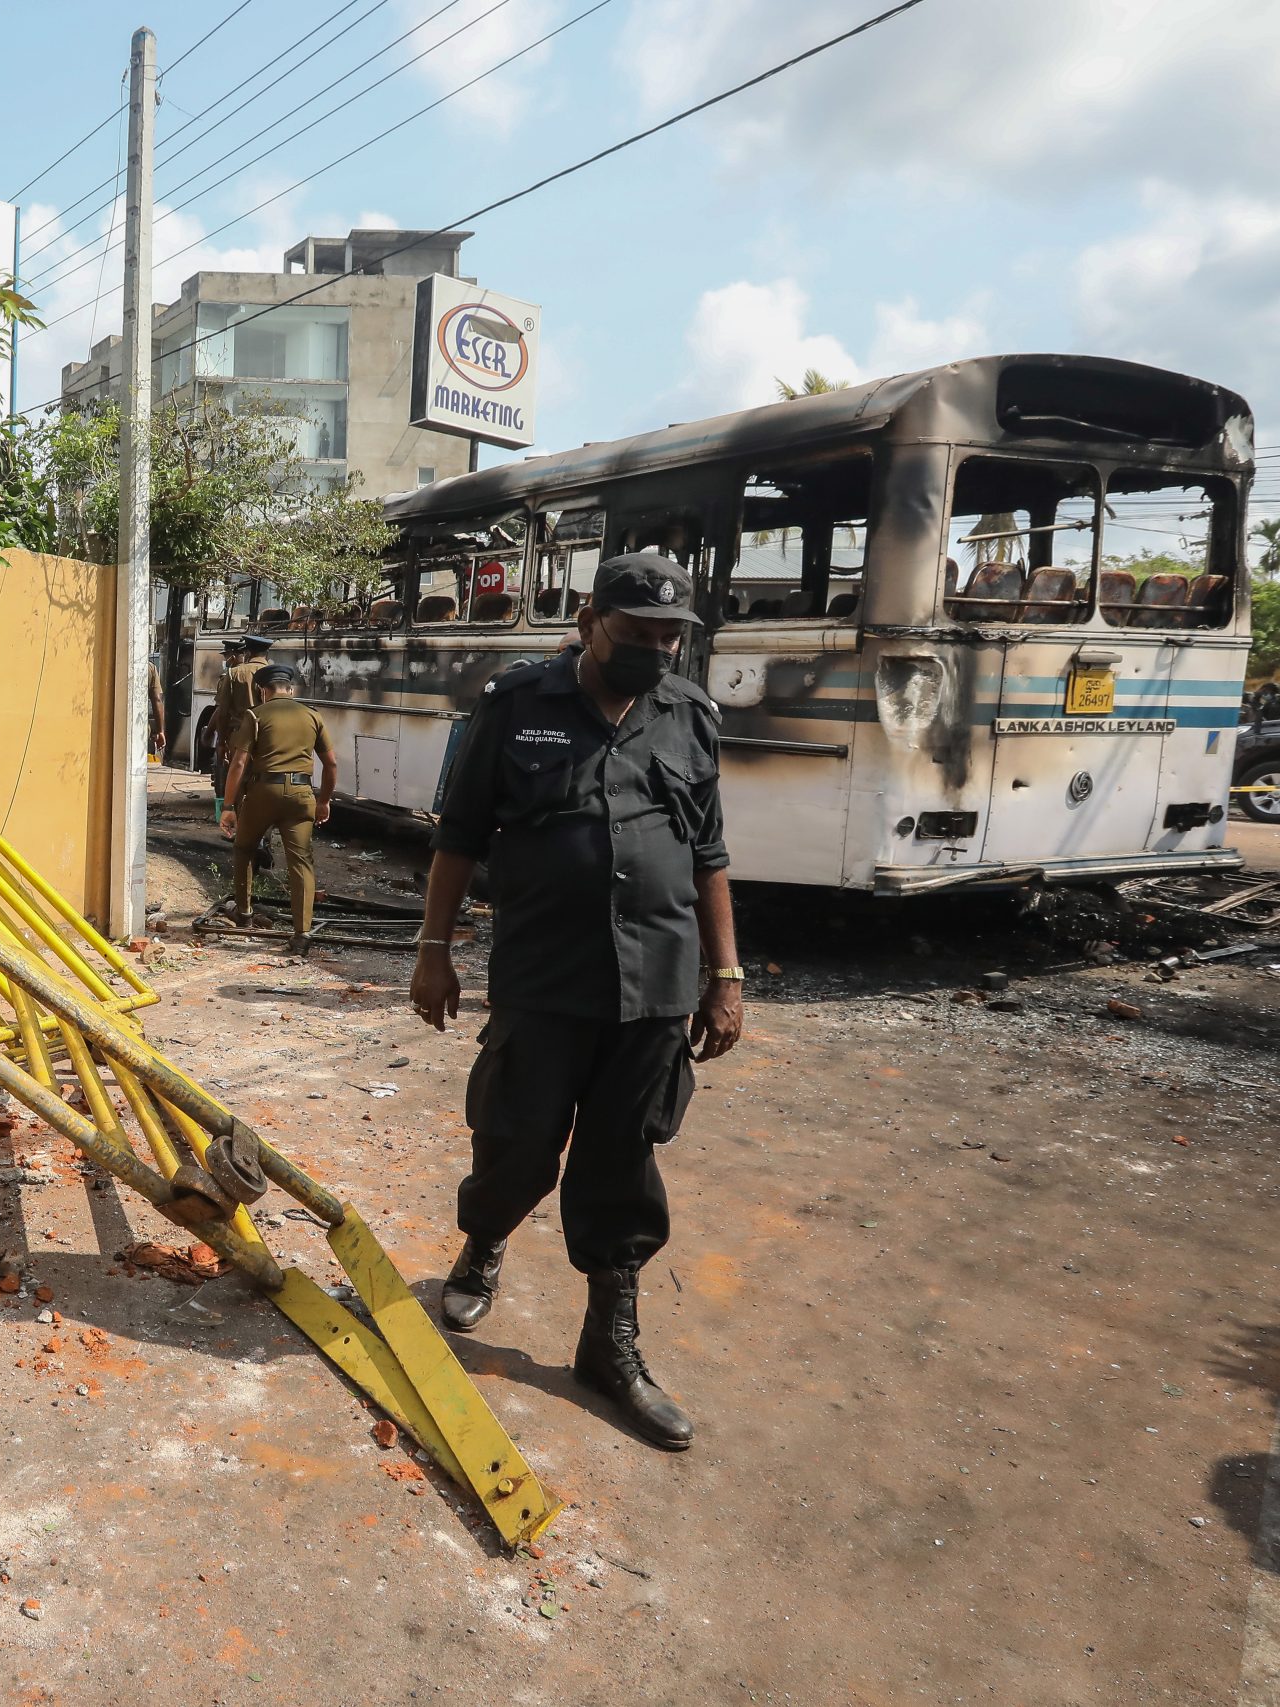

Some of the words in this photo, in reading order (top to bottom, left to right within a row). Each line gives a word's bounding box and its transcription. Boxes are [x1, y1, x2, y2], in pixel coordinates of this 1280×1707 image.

[434, 384, 524, 431] MARKETING
[465, 573, 501, 590] OP
[1078, 694, 1110, 707] 26497
[996, 720, 1051, 732] LANKA
[1054, 720, 1106, 732] ASHOK
[1108, 720, 1176, 732] LEYLAND
[515, 734, 534, 742] HEAD
[534, 736, 571, 745] QUARTERS
